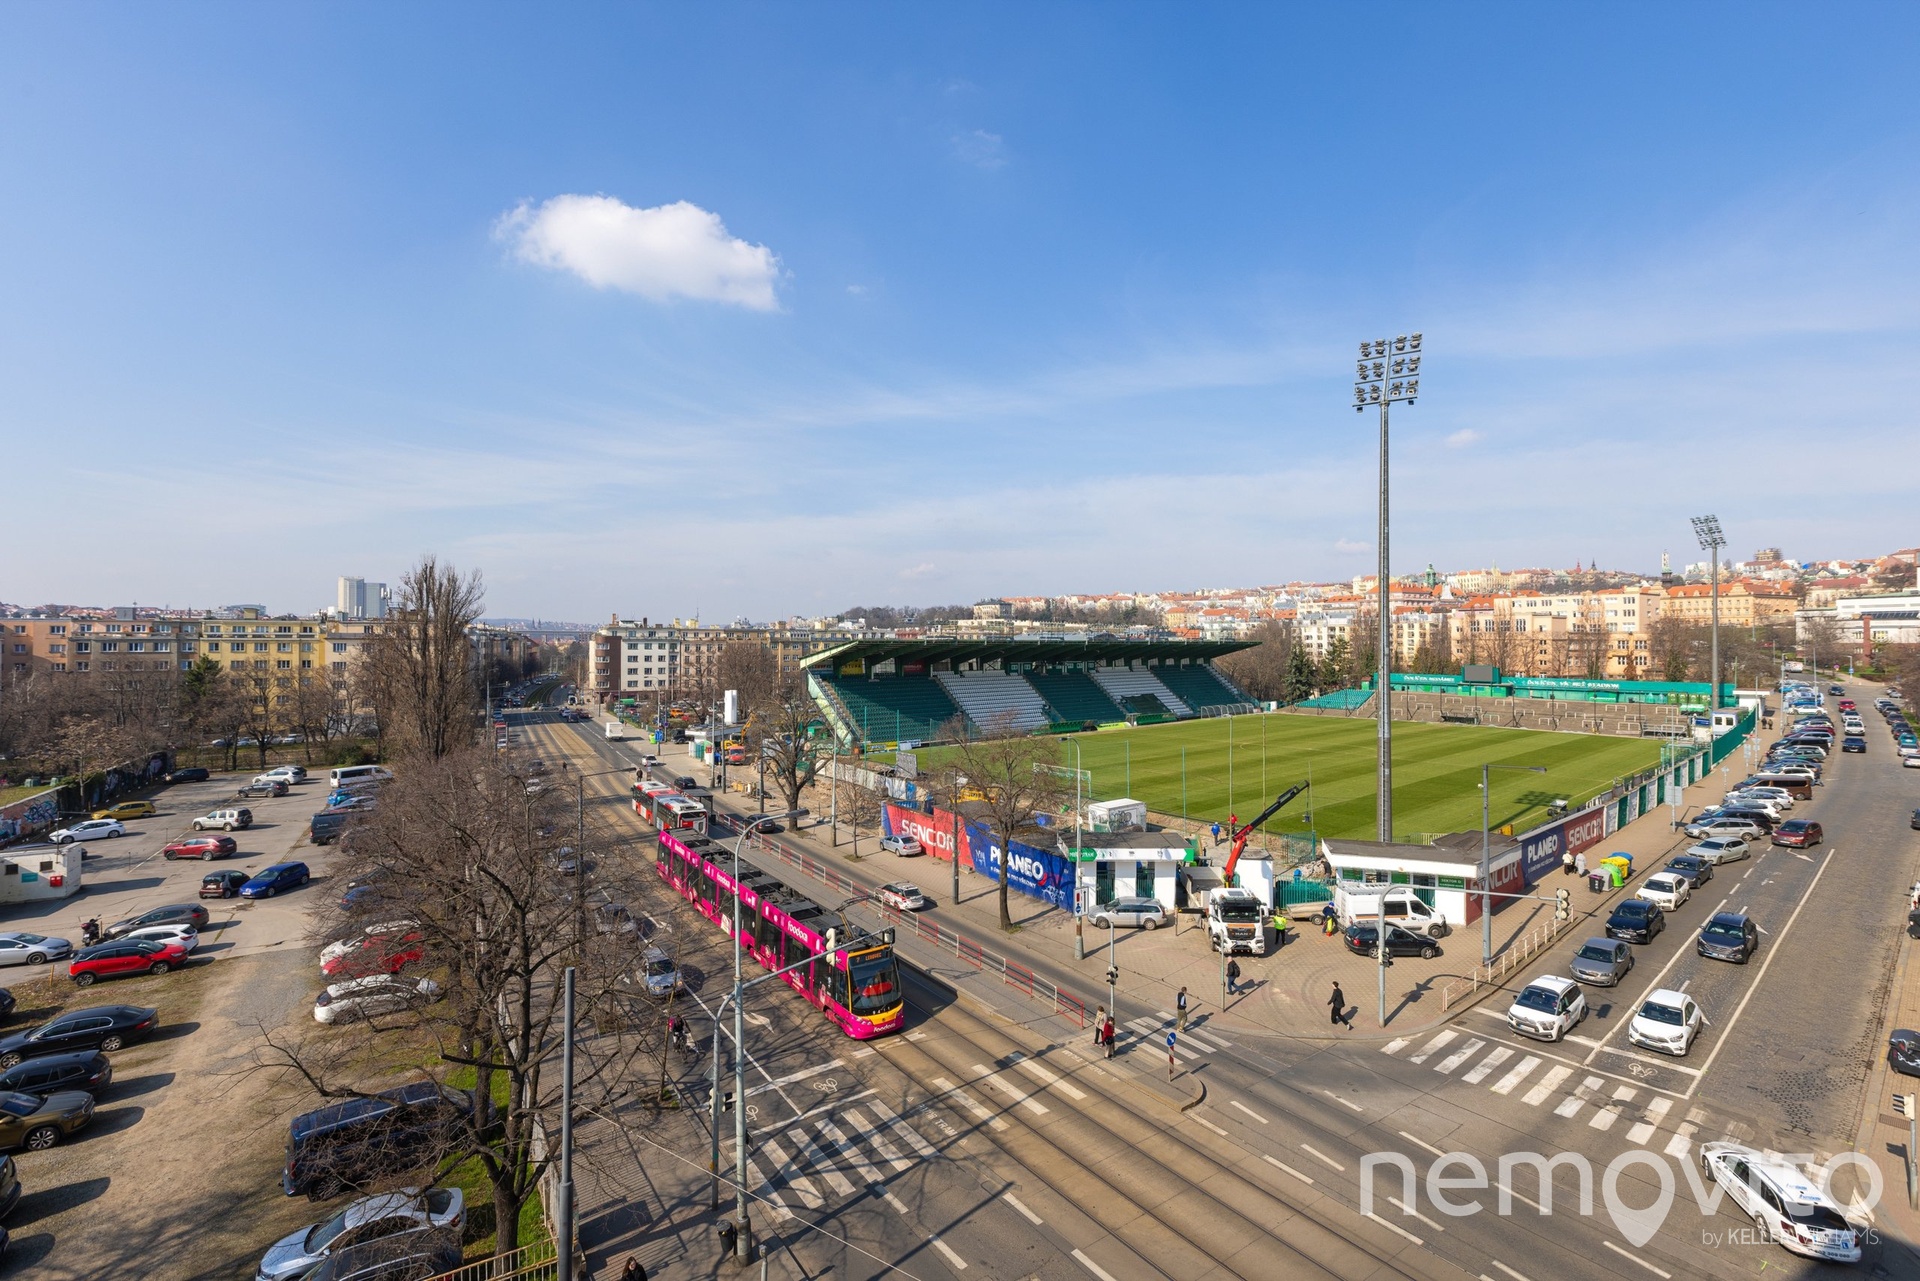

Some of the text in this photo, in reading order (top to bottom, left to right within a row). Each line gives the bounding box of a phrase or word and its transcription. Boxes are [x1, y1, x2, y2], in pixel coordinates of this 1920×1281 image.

[902, 819, 955, 851] SENCOR
[1568, 817, 1602, 849] SENCOR
[1527, 834, 1558, 864] PLANEO
[787, 920, 808, 943] foodora
[873, 1023, 896, 1033] foodora
